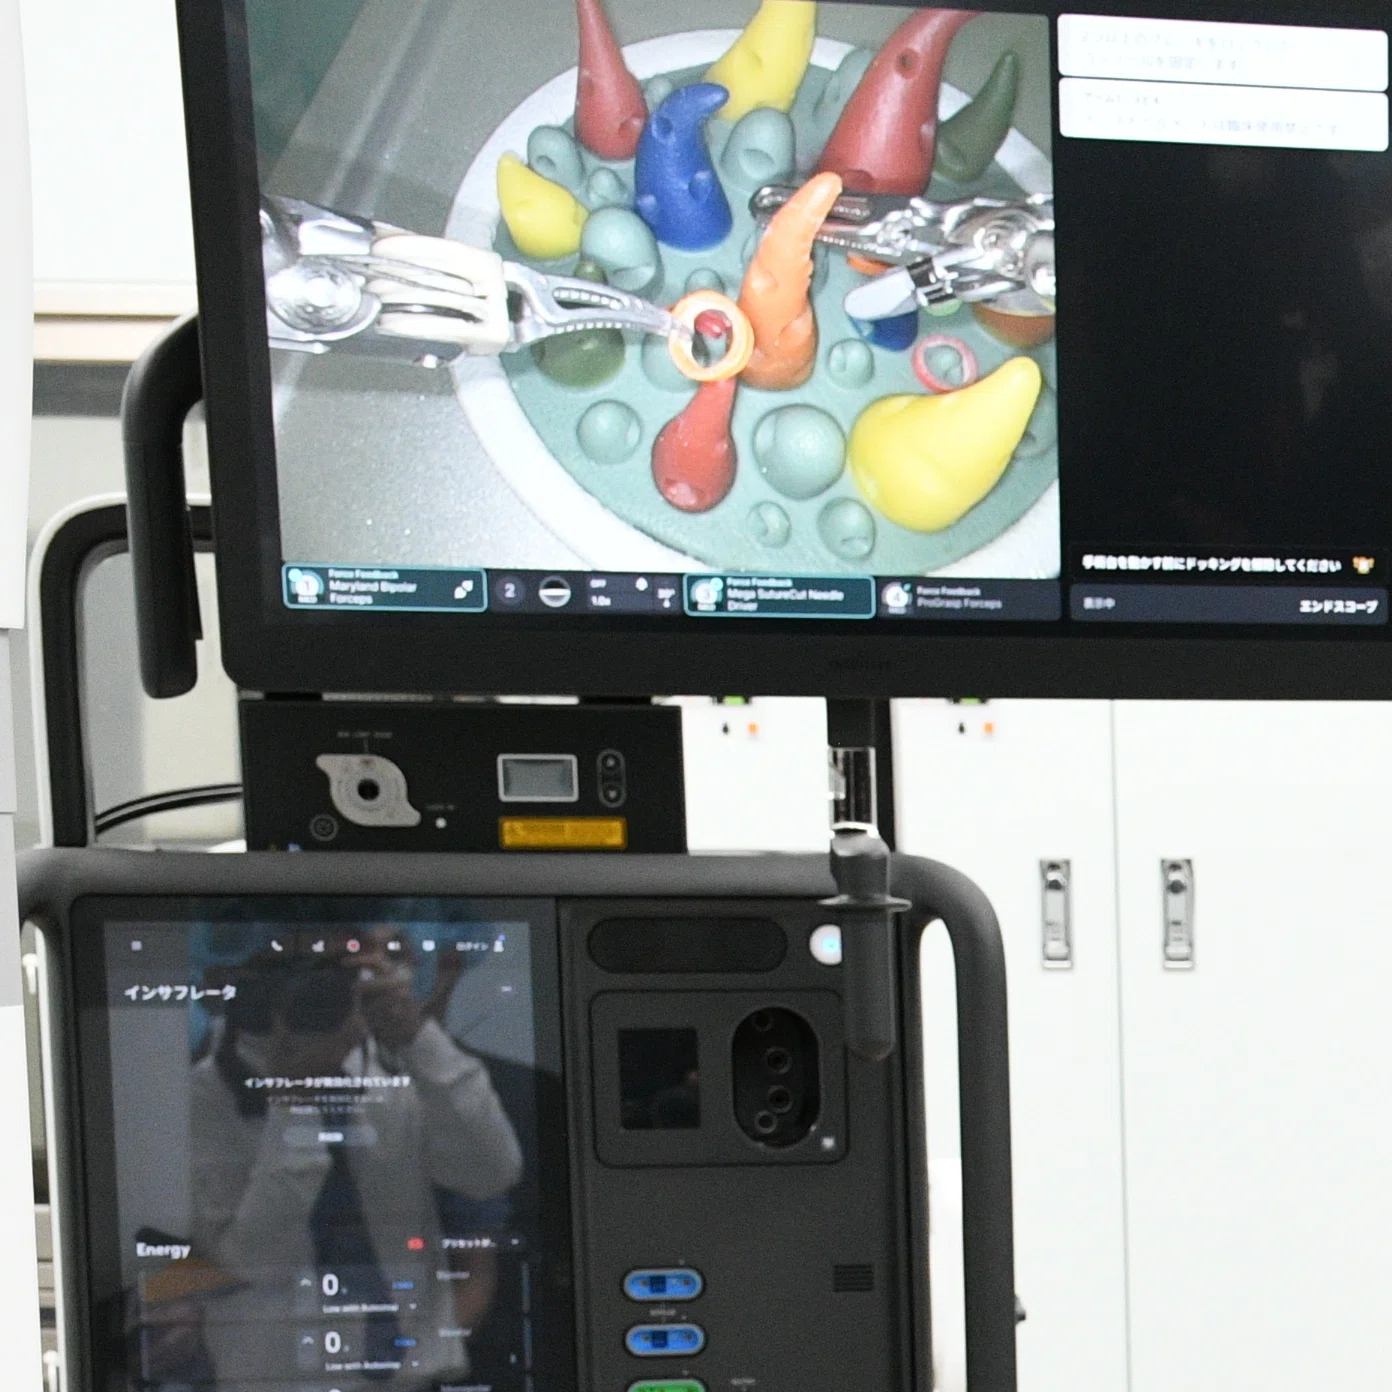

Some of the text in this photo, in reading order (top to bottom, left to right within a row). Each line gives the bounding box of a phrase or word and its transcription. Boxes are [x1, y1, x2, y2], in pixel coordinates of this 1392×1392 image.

[504, 583, 515, 598] 2
[1299, 599, 1378, 614] エンドスコープ
[124, 984, 237, 1001] インサフレータ
[136, 1242, 191, 1259] Energy
[322, 1273, 339, 1296] 0
[325, 1331, 341, 1354] 0
